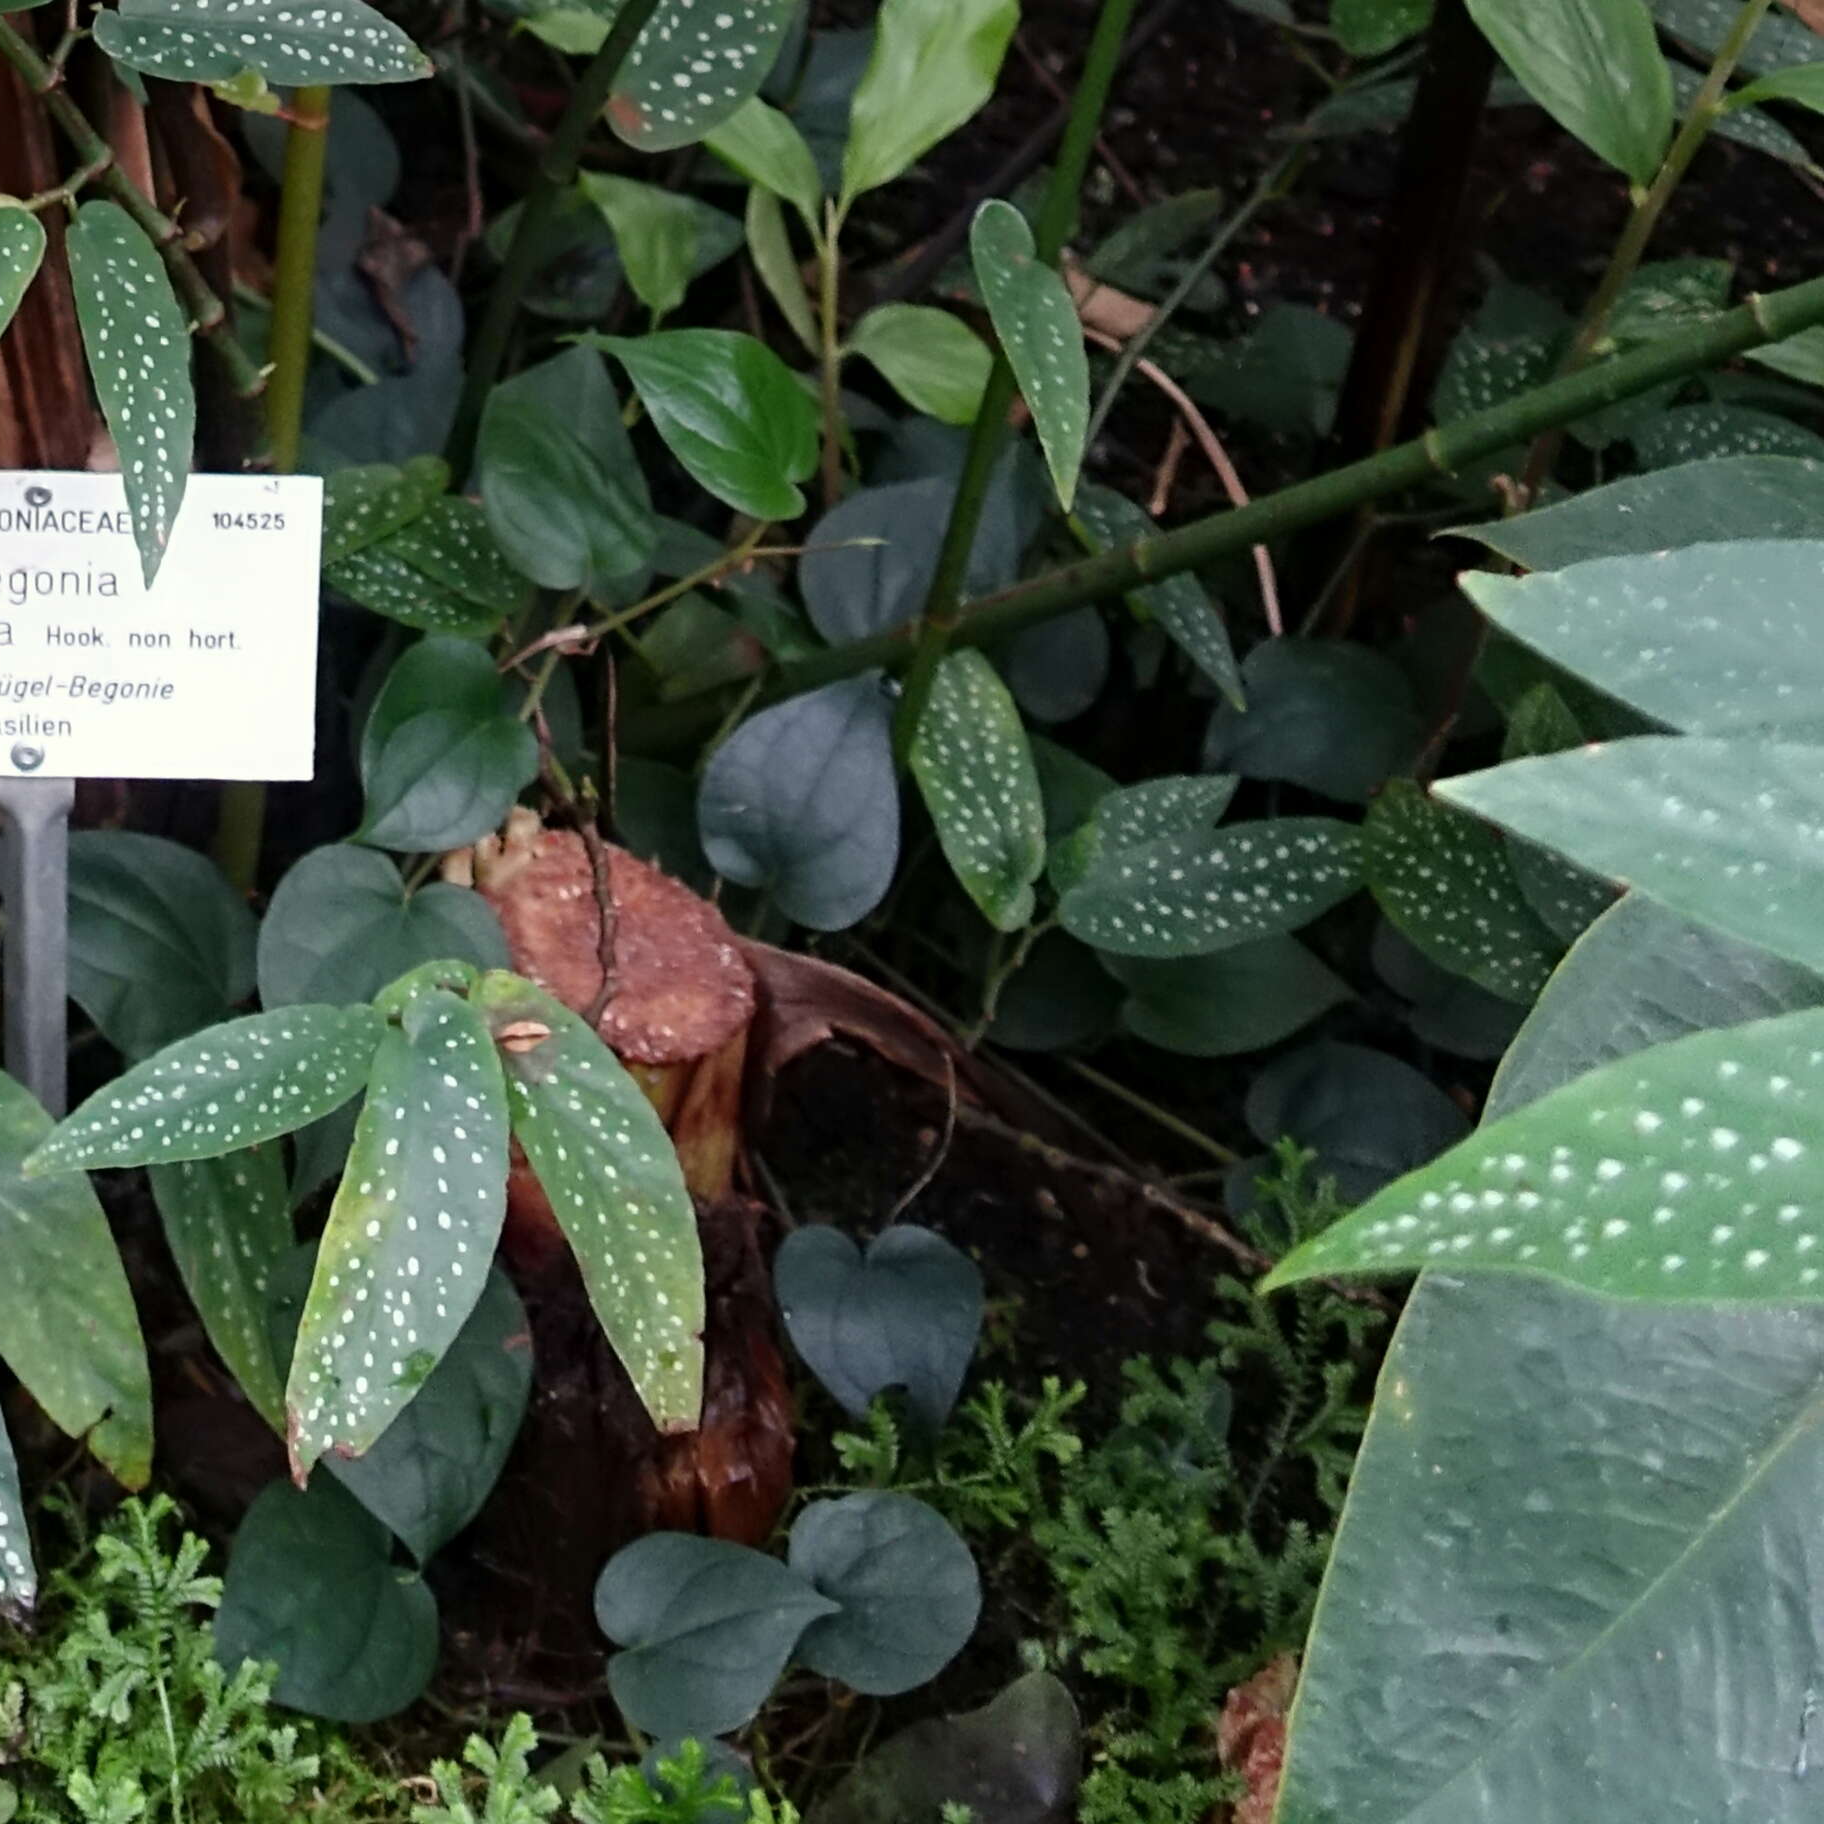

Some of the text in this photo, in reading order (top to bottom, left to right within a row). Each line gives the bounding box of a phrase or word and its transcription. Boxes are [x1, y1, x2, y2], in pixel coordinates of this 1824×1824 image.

[213, 512, 286, 531] 104525
[128, 631, 171, 649] non
[188, 627, 242, 650] hort.
